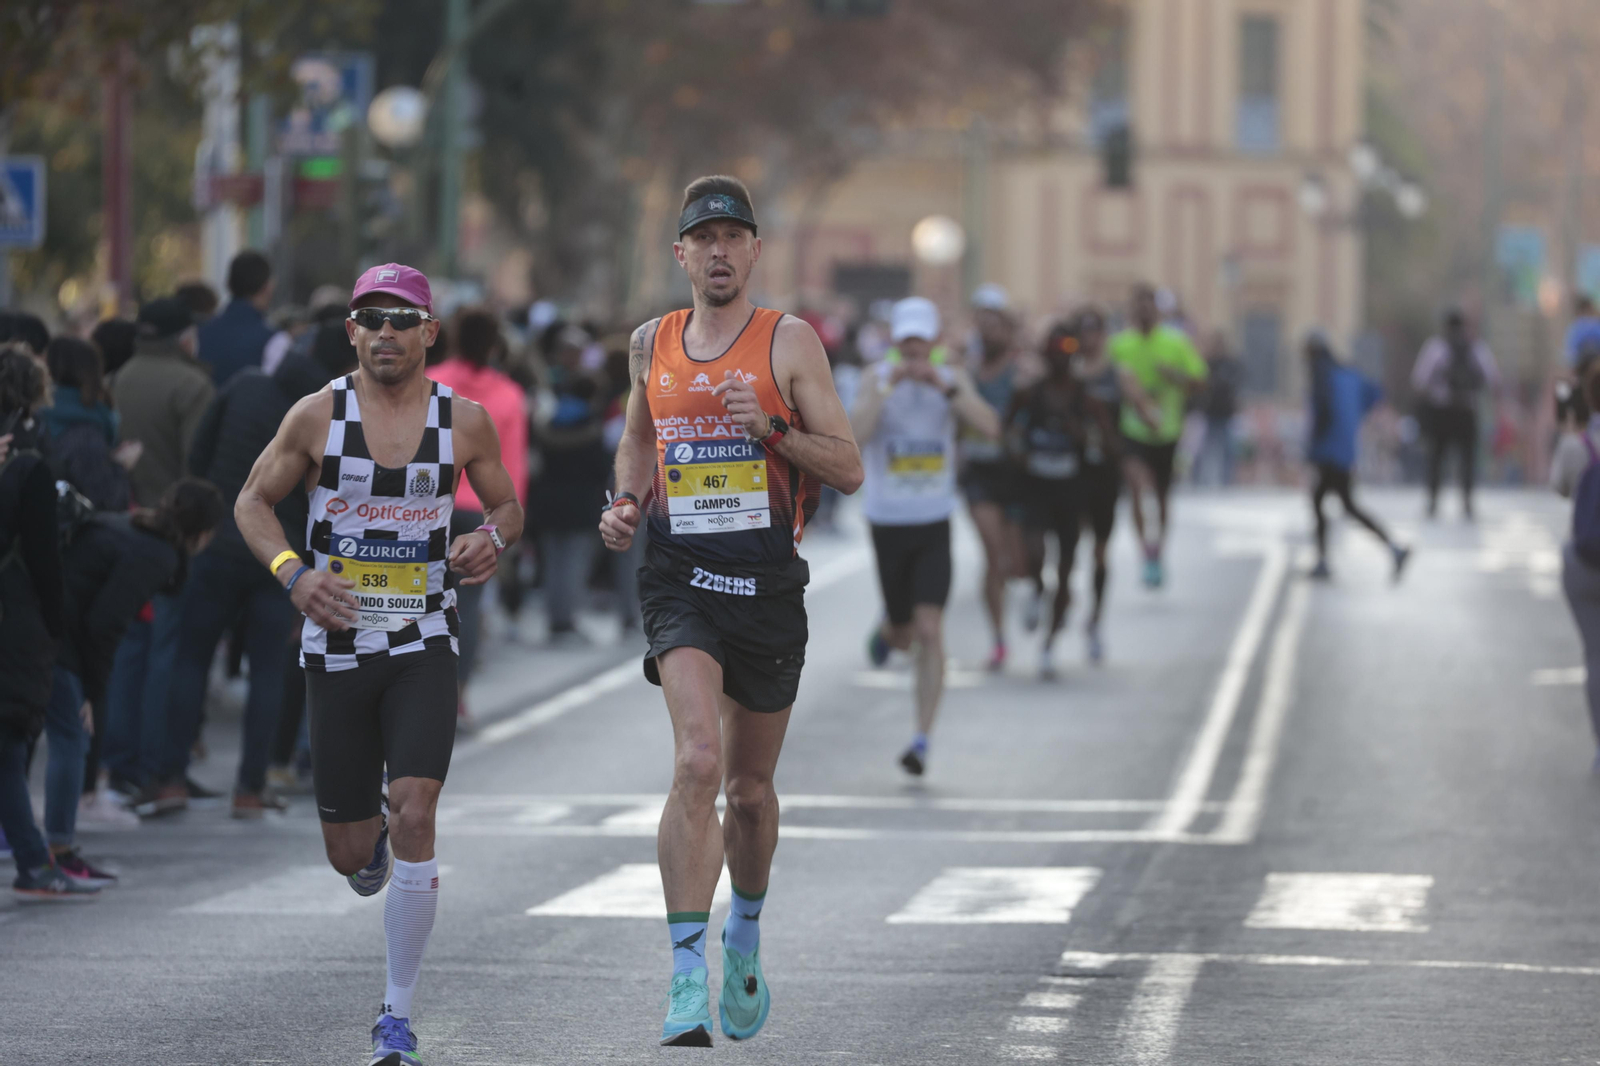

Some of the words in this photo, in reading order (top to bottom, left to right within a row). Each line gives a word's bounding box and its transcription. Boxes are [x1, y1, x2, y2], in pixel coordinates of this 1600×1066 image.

[697, 444, 753, 459] ZURICH
[341, 473, 367, 483] COFIDES
[703, 474, 728, 489] 467
[694, 496, 741, 510] CAMPOS
[356, 502, 439, 522] OptiCenter
[358, 545, 416, 559] ZURICH
[361, 573, 388, 588] 538
[689, 566, 757, 597] 226ERS
[387, 597, 424, 609] SOUZA
